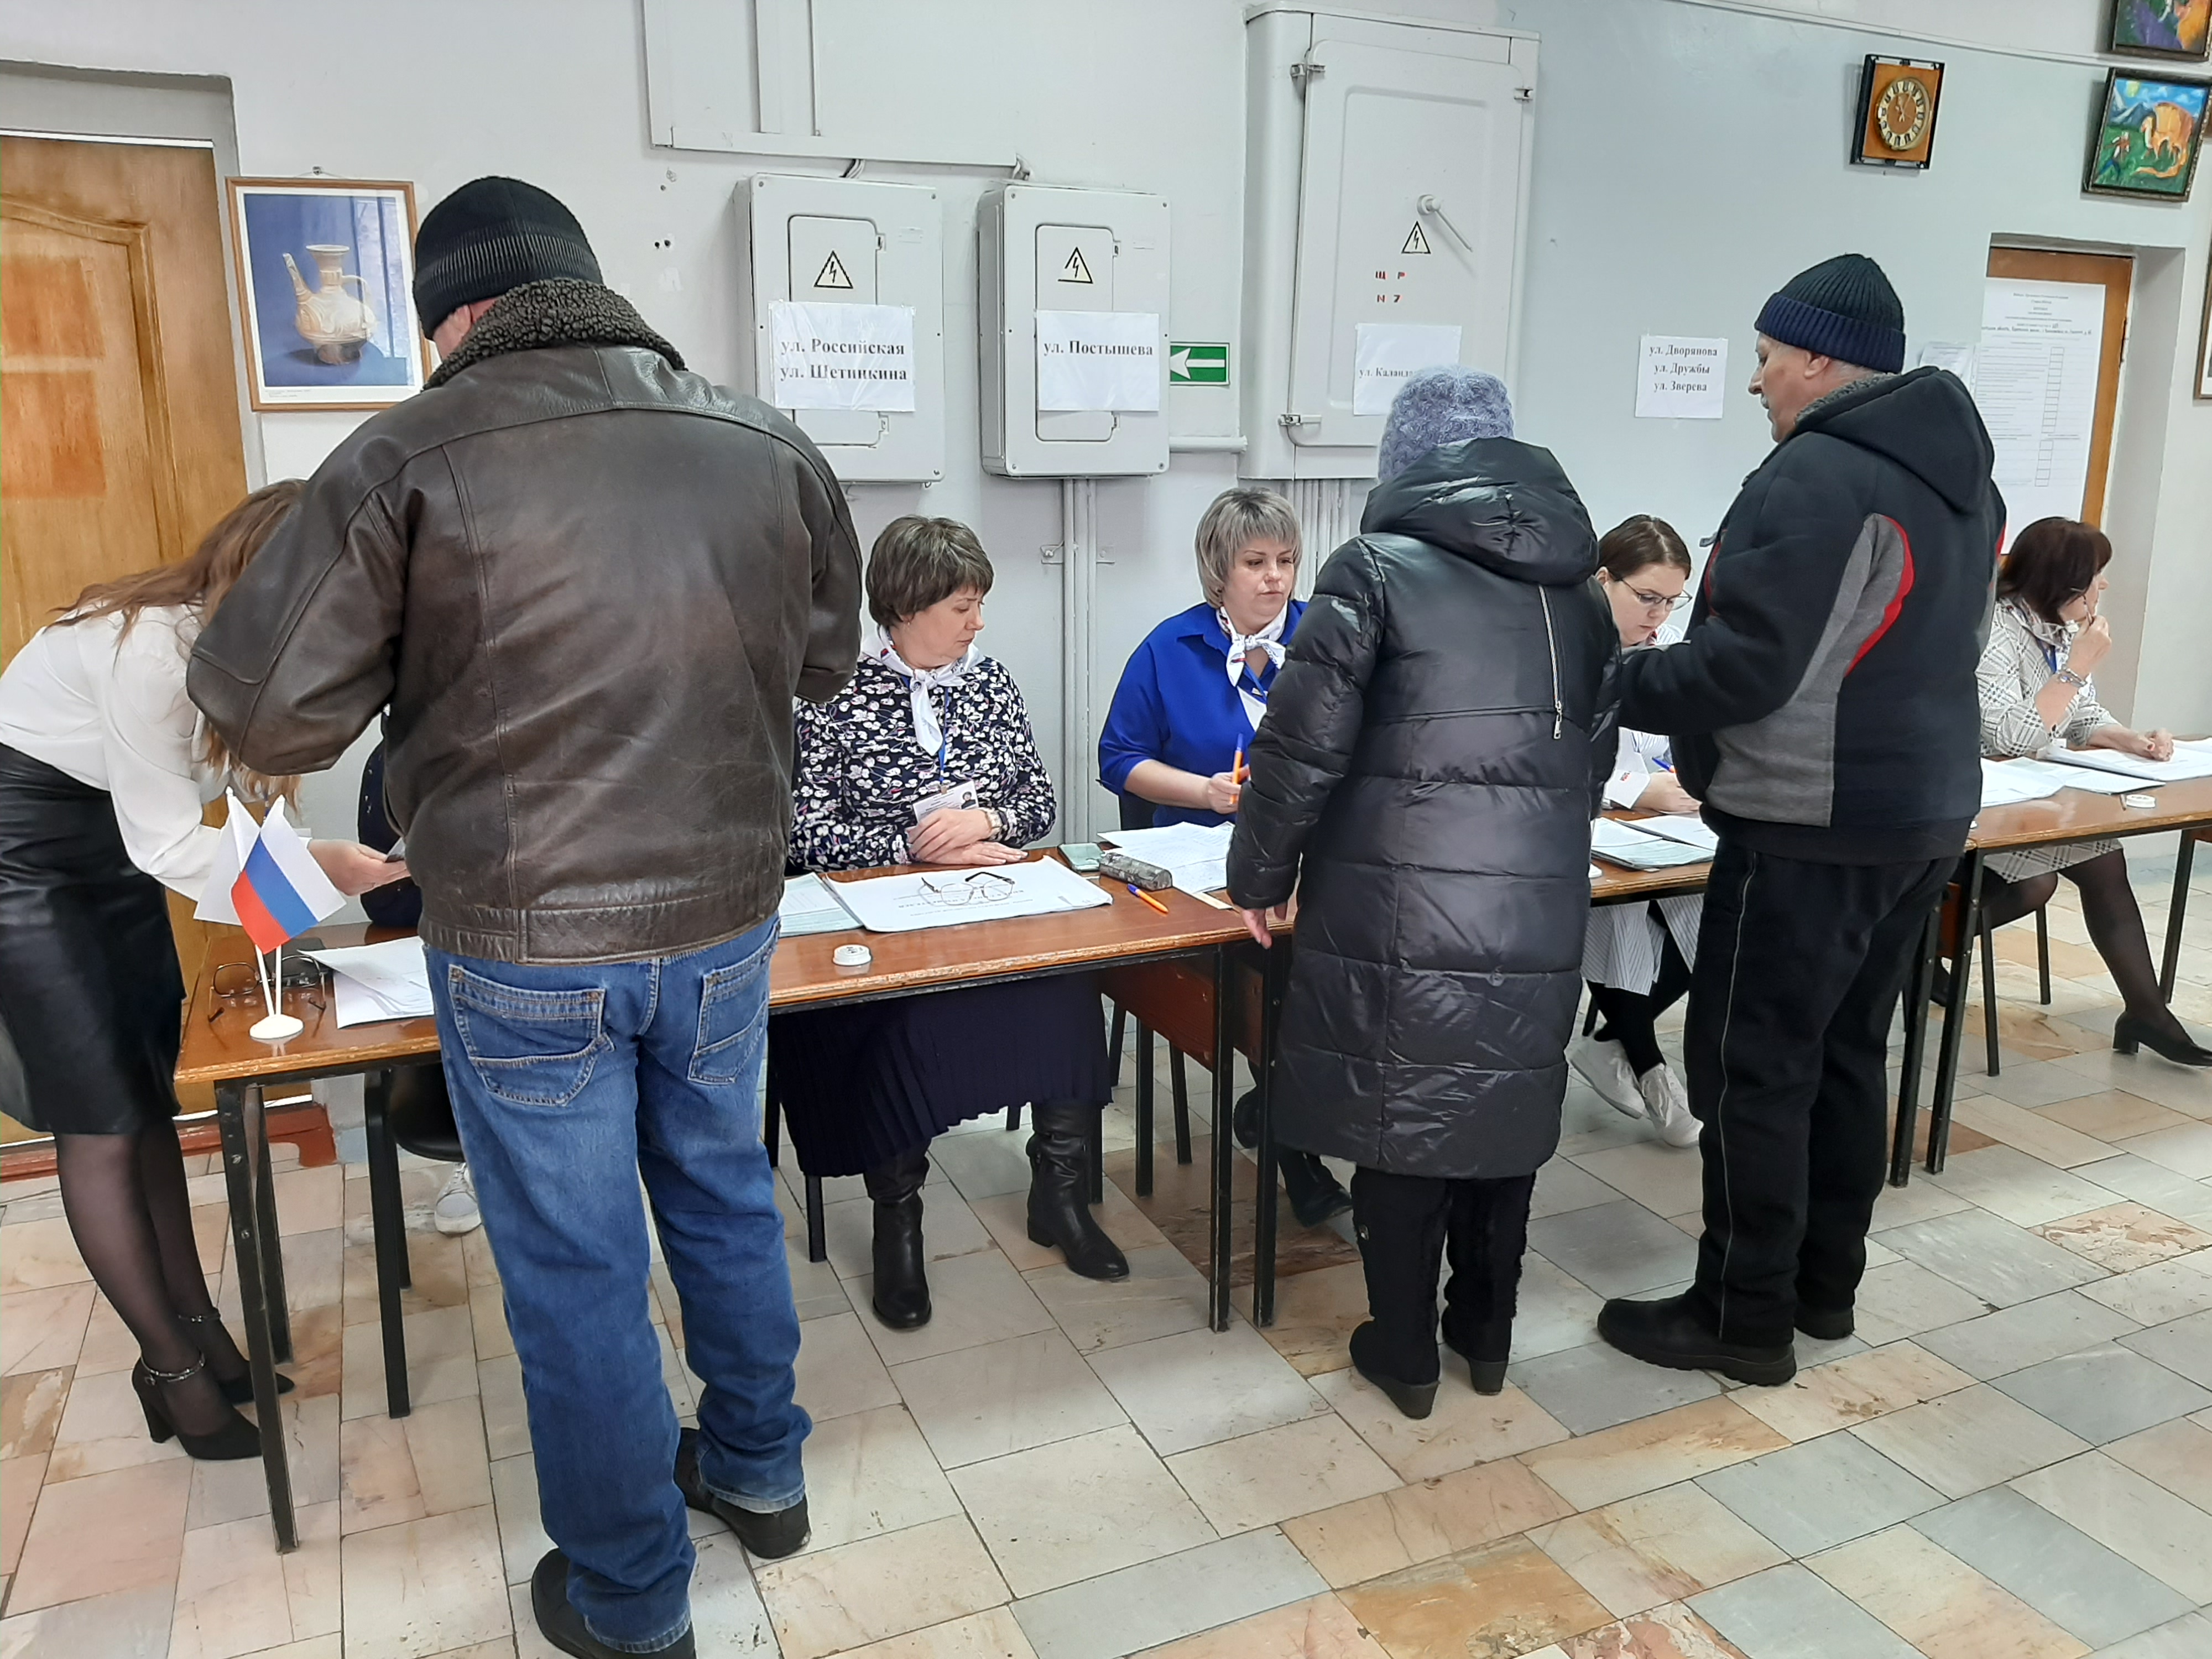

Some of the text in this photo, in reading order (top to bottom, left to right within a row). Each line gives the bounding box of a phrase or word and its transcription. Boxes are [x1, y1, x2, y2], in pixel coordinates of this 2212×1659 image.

[1393, 294, 1401, 303] 7
[781, 338, 905, 356] ул. Российская
[1044, 341, 1153, 357] ул. Постышева
[1649, 345, 1718, 358] ул. Дворянова
[780, 368, 804, 382] ул.
[1359, 369, 1373, 379] ул.
[1654, 362, 1710, 376] ул. Дружбы
[1654, 380, 1707, 394] ул. Зверева
